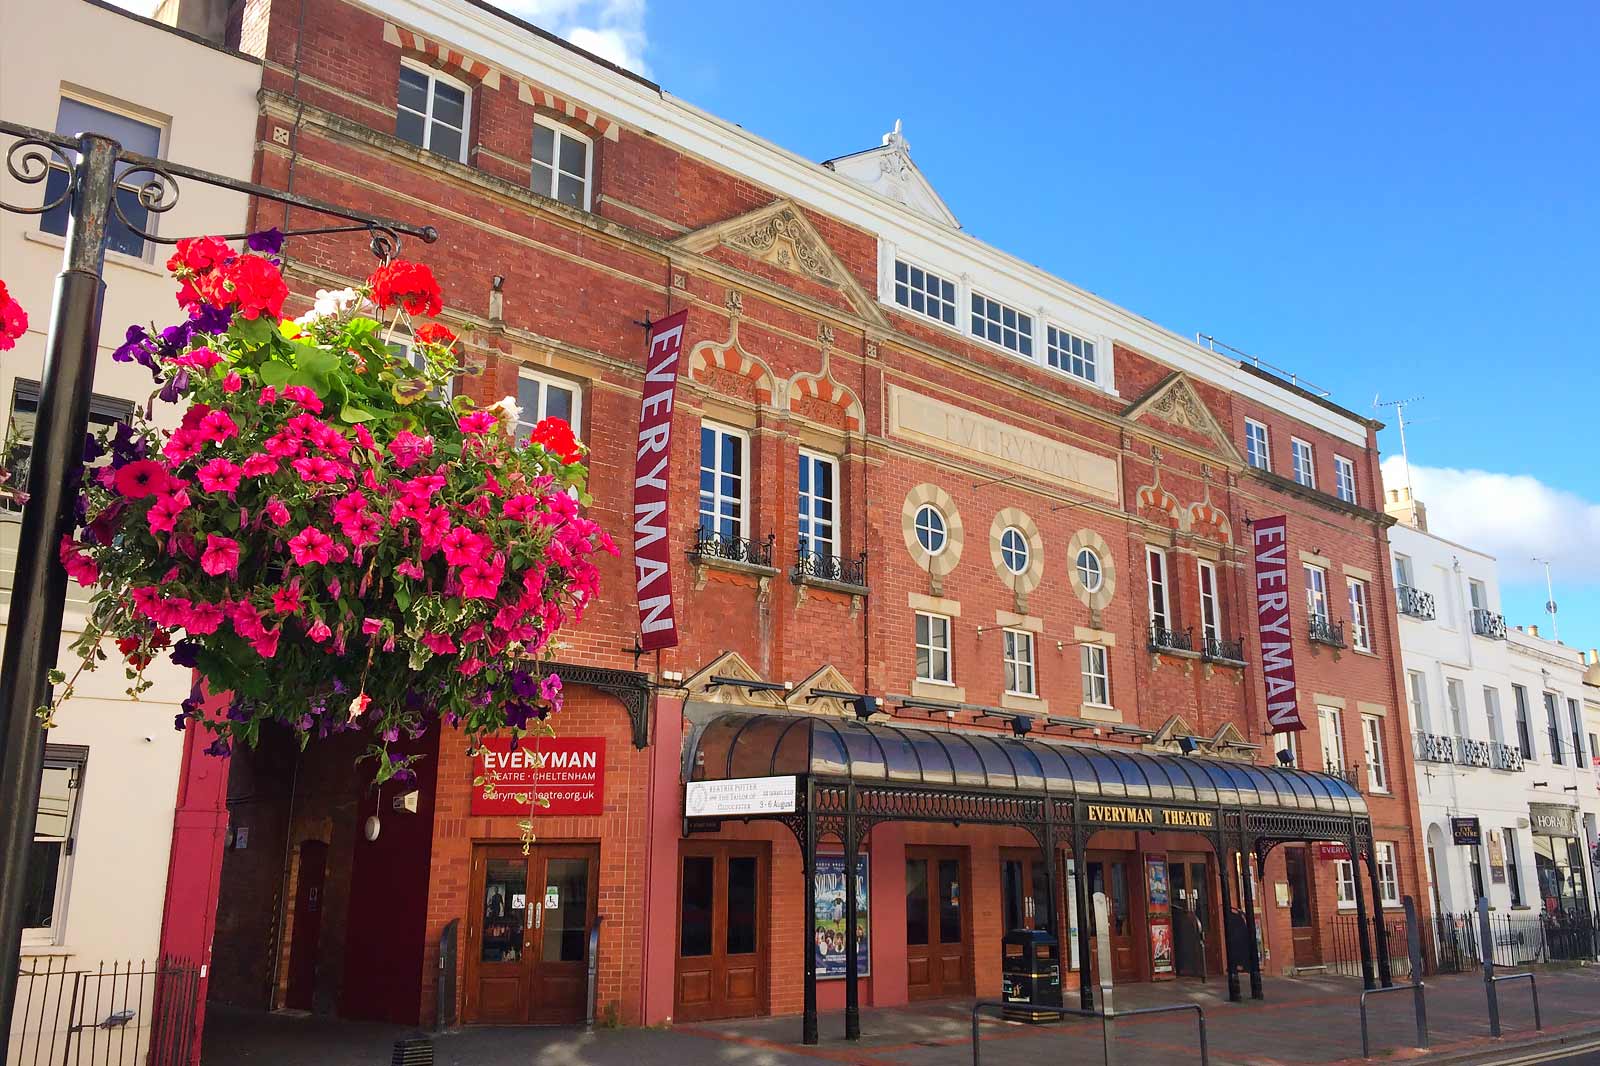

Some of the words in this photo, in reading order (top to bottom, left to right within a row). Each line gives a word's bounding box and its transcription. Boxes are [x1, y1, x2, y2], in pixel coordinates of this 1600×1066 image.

[944, 412, 1081, 482] EVERYMAN
[635, 324, 683, 633] EVERYMAN
[1255, 525, 1298, 726] EVERYMAN
[485, 751, 597, 769] EVERYMAN
[532, 772, 596, 781] CHELTENHAM
[482, 789, 595, 802] eerymtheatre.org.uk
[773, 800, 793, 809] August
[1088, 805, 1153, 823] EVERYMAN
[1163, 809, 1213, 827] THEATRE
[815, 873, 837, 898] SOUND
